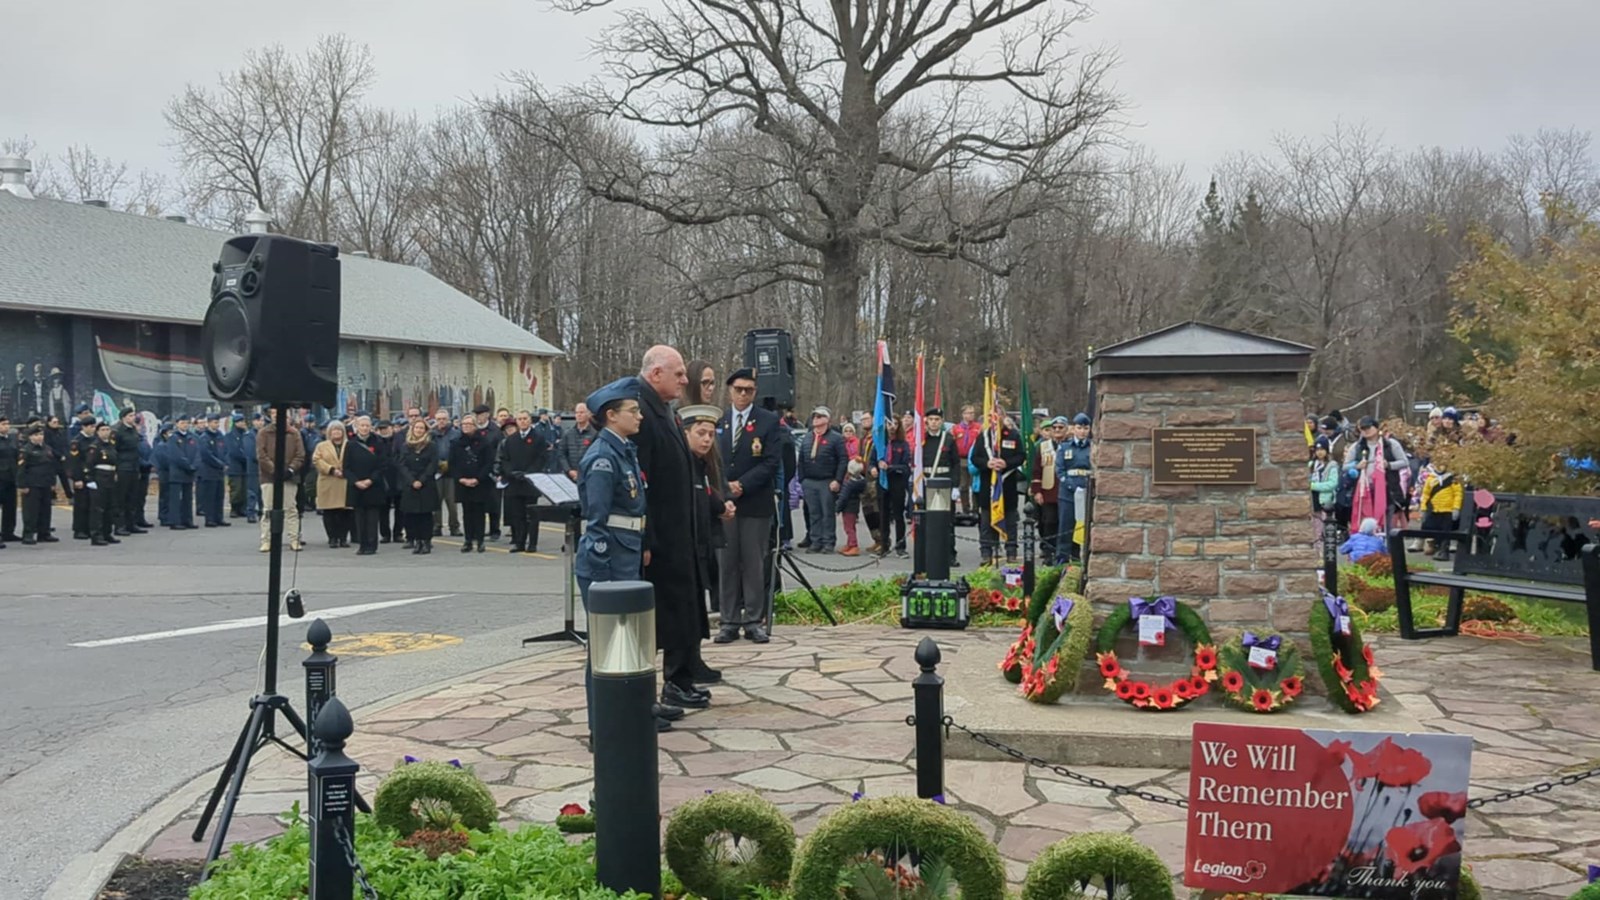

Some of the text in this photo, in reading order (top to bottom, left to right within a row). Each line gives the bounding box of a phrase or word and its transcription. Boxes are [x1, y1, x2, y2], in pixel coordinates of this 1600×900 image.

[1199, 740, 1296, 771] We Will
[1197, 776, 1349, 810] Remember
[1195, 811, 1273, 841] Them
[1193, 858, 1243, 877] Legion
[1346, 865, 1448, 896] Thank you
